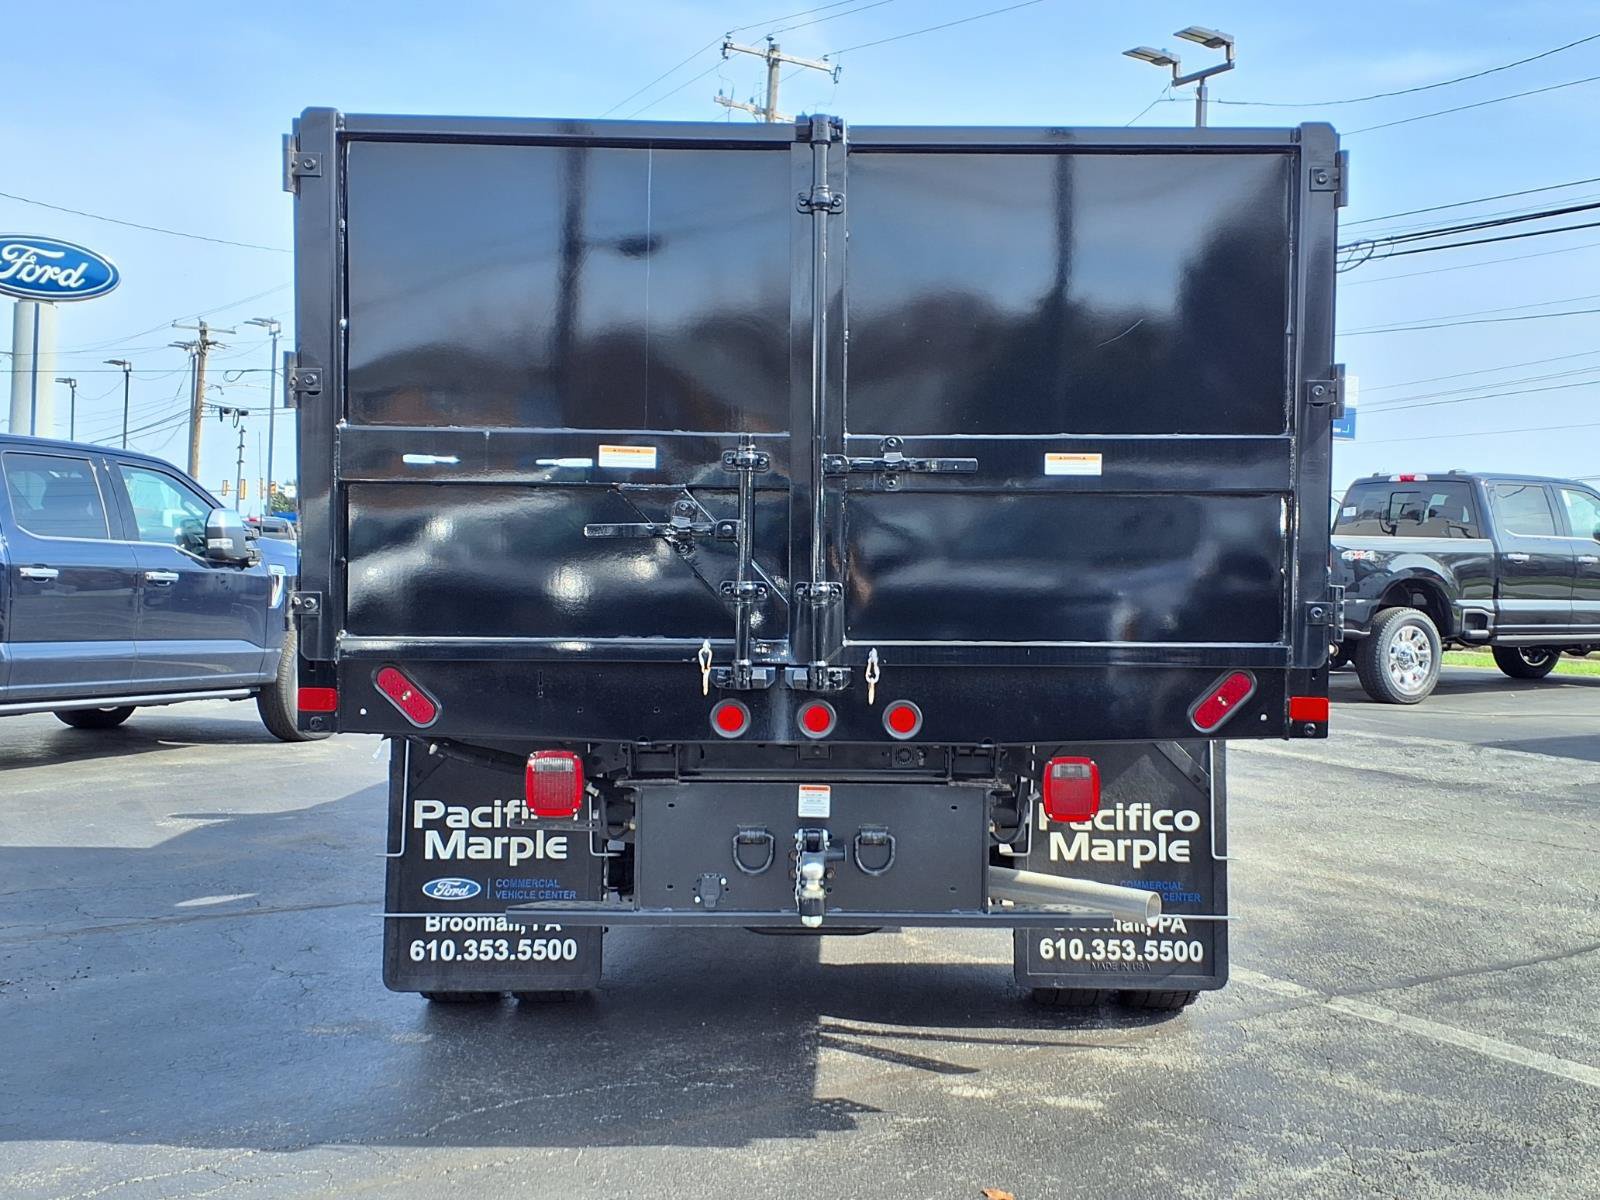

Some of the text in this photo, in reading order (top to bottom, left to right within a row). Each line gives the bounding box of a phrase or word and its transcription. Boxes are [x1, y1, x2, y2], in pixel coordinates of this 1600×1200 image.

[0, 243, 88, 288] Ford
[413, 799, 577, 829] Pacifi
[424, 829, 568, 867] Marple
[1050, 832, 1191, 869] Marple
[433, 881, 469, 896] Ford
[495, 879, 561, 888] COMMERCIAL
[1120, 880, 1184, 890] COMMERCIAL
[495, 890, 577, 900] VEHICLE CENTER
[1162, 892, 1201, 902] CENTER
[1158, 917, 1188, 934] PA
[410, 939, 578, 962] 610.353.5500
[1039, 938, 1204, 963] 610.353.5500
